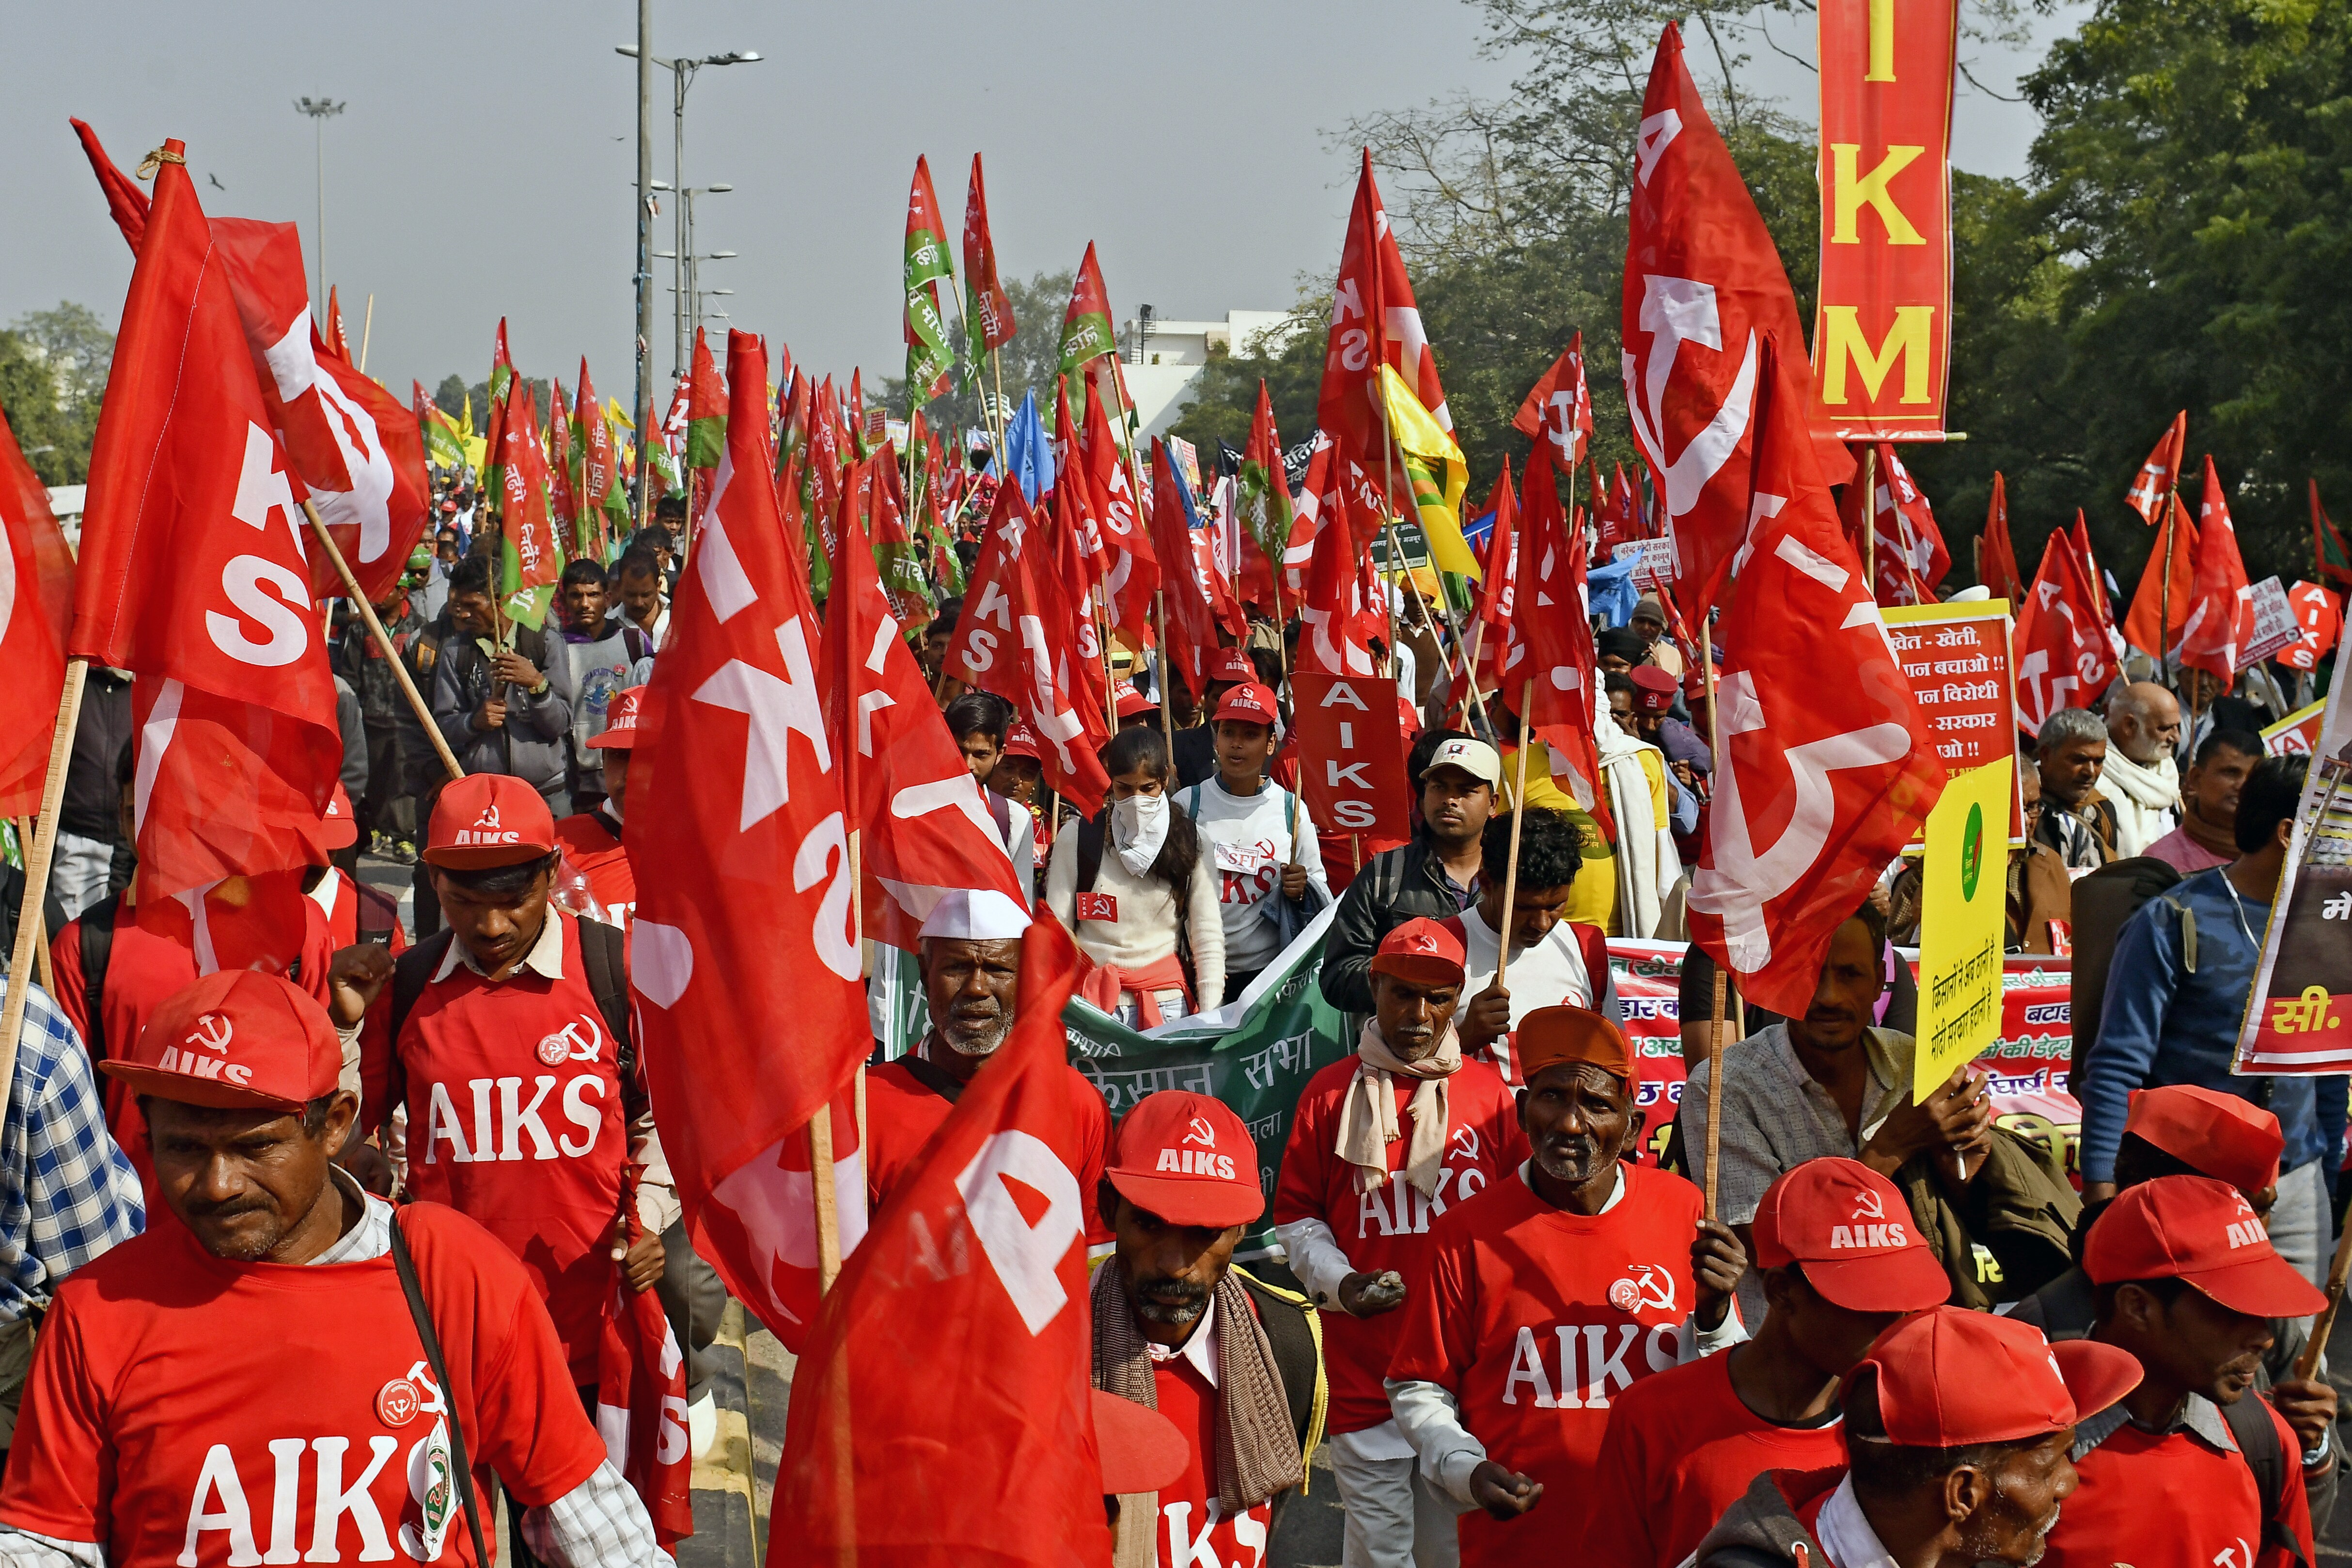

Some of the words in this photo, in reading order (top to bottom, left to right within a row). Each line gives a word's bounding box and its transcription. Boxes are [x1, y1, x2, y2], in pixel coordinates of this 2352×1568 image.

[1935, 653, 1989, 676] बचाओ
[1943, 679, 1999, 703] विरोधी
[1230, 698, 1261, 710] AIKS
[1935, 713, 1997, 731] सरकार
[1319, 681, 1377, 828] AIKS
[1228, 852, 1257, 869] SFI
[1239, 1027, 1316, 1091] सभा
[425, 1074, 605, 1164] AIKS
[1156, 1148, 1236, 1180] AIKS
[1830, 1223, 1908, 1250] AIKS
